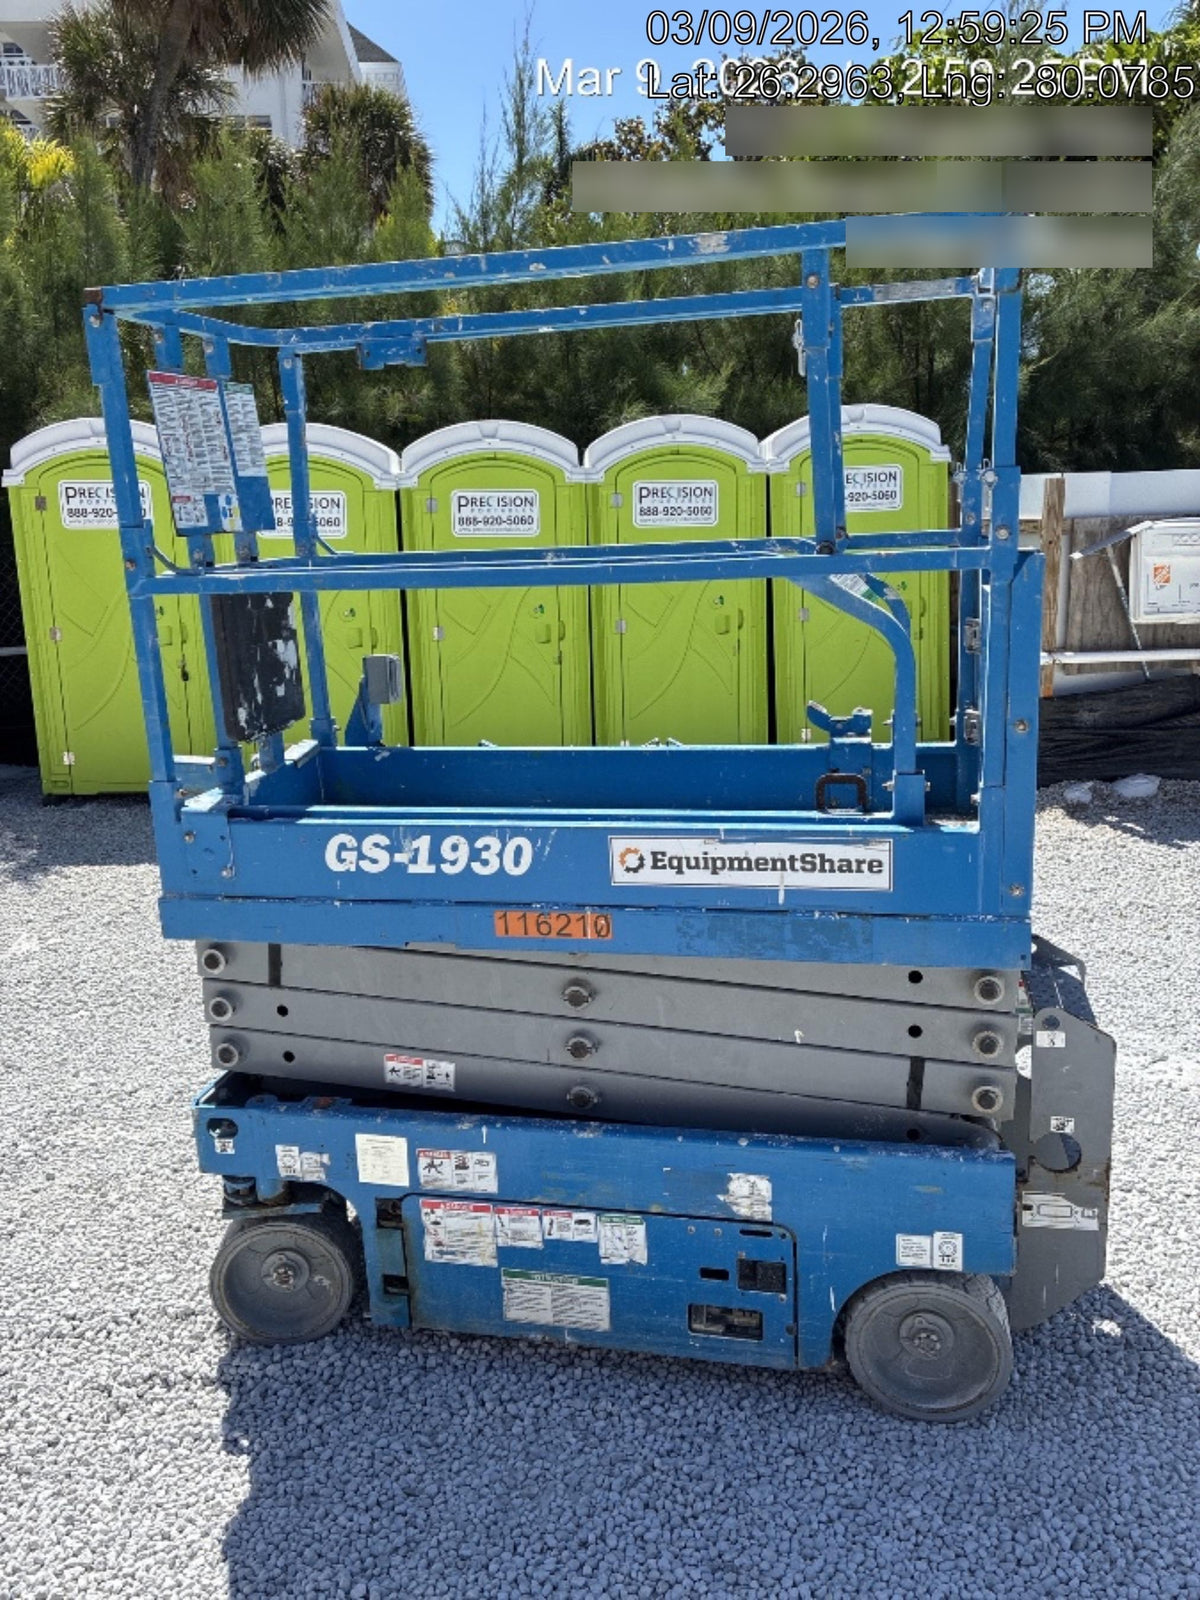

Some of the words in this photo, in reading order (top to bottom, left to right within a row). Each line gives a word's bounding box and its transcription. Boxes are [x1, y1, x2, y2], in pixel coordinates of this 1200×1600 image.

[846, 471, 897, 485] ECISION
[458, 495, 534, 513] PRECISION
[639, 486, 713, 504] PRECISION
[640, 506, 713, 516] 888-920-5060
[458, 515, 534, 527] 888-920-5060
[324, 833, 533, 876] GS-1930
[650, 850, 884, 875] EquipmentShare
[498, 911, 611, 938] 116210
